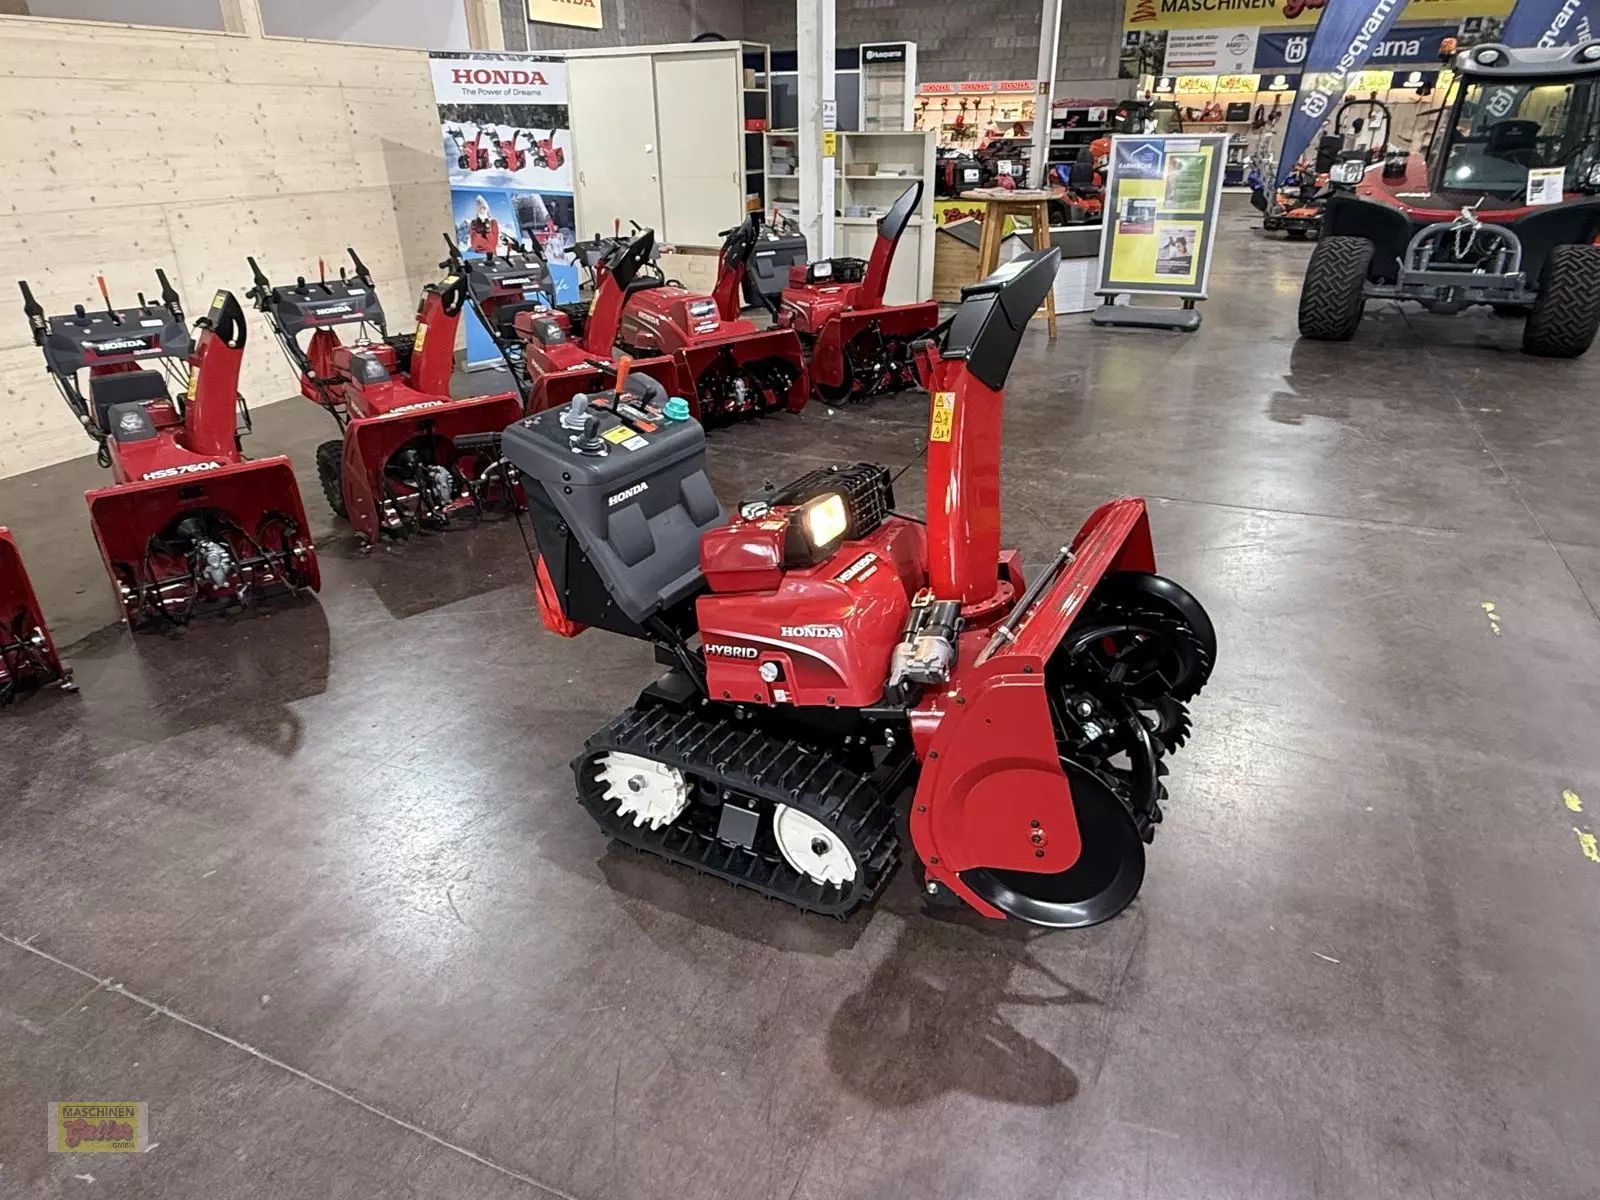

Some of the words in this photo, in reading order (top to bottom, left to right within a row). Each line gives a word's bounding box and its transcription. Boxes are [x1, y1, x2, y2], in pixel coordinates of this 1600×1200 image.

[1161, 0, 1276, 13] MASCHINEN
[451, 68, 549, 85] HONDA
[461, 87, 476, 96] The
[478, 87, 501, 96] Power
[503, 87, 511, 96] of
[513, 88, 542, 96] Dreams
[1001, 81, 1034, 90] HONDA
[316, 305, 353, 316] HONDA
[98, 340, 147, 351] HONDA
[142, 461, 221, 481] HSS760A
[608, 481, 649, 507] HONDA
[781, 626, 843, 638] HONDA
[705, 643, 758, 659] HYBRID
